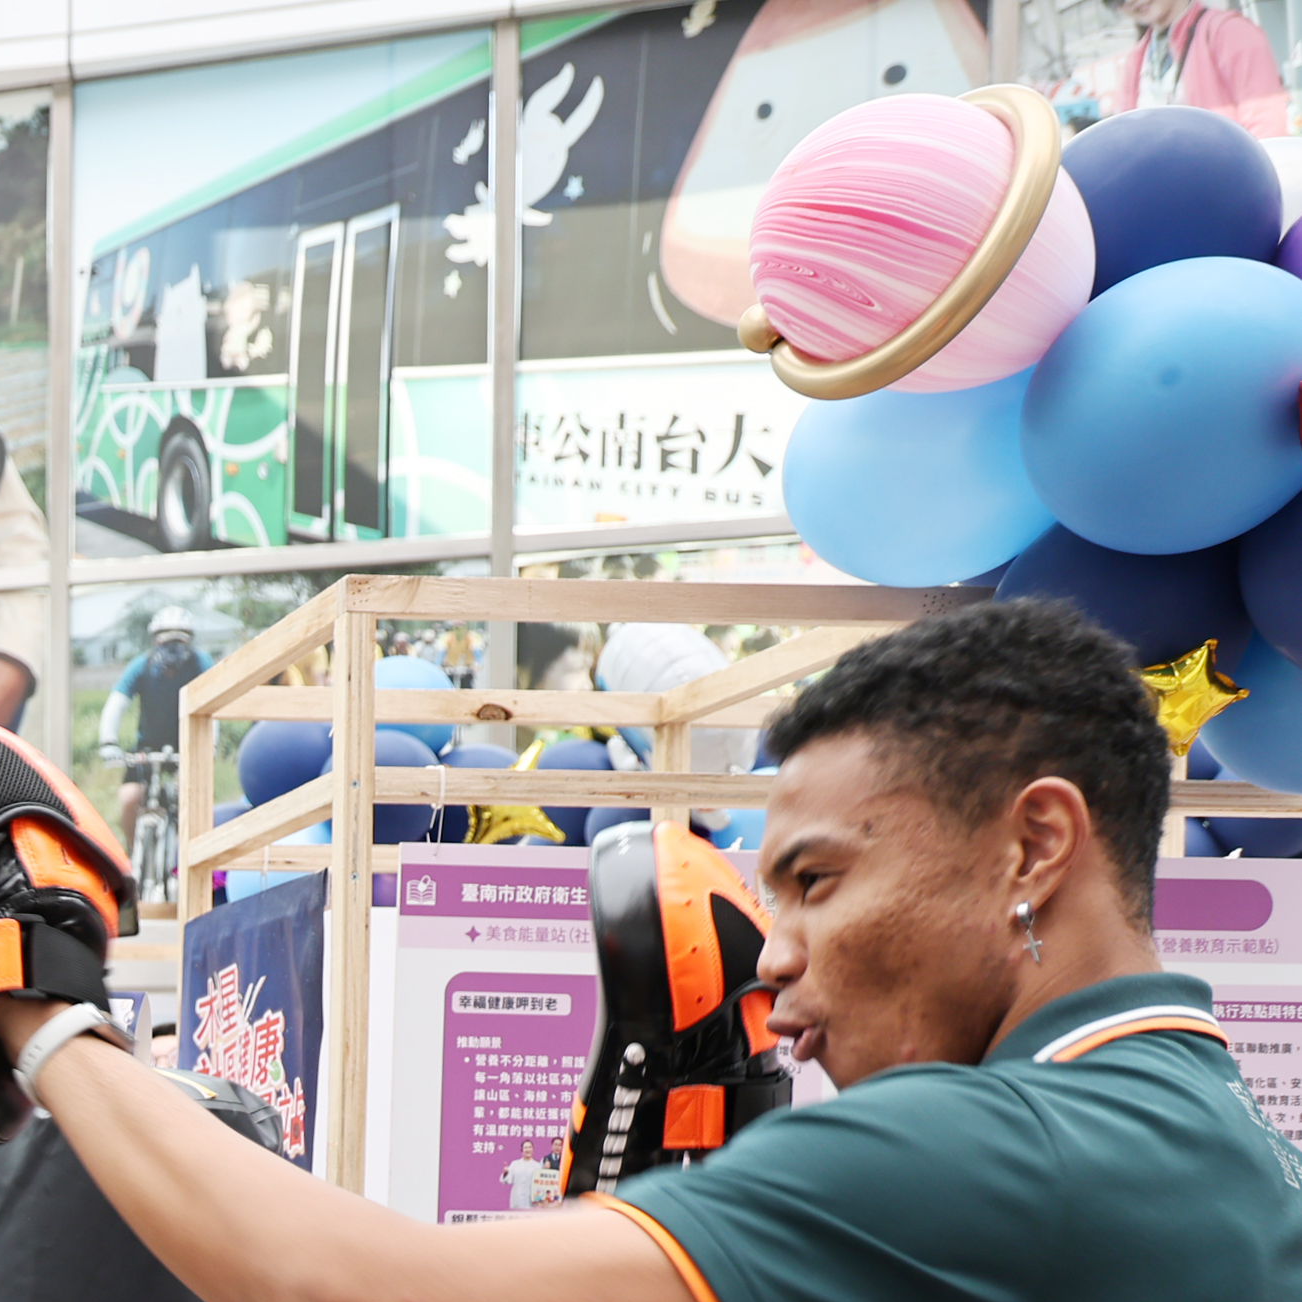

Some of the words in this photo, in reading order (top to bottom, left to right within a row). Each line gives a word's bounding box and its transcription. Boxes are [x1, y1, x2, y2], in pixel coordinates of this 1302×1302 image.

[619, 481, 679, 500] CITY
[705, 490, 764, 508] BUS
[459, 995, 558, 1012] 幸福健康呷到老
